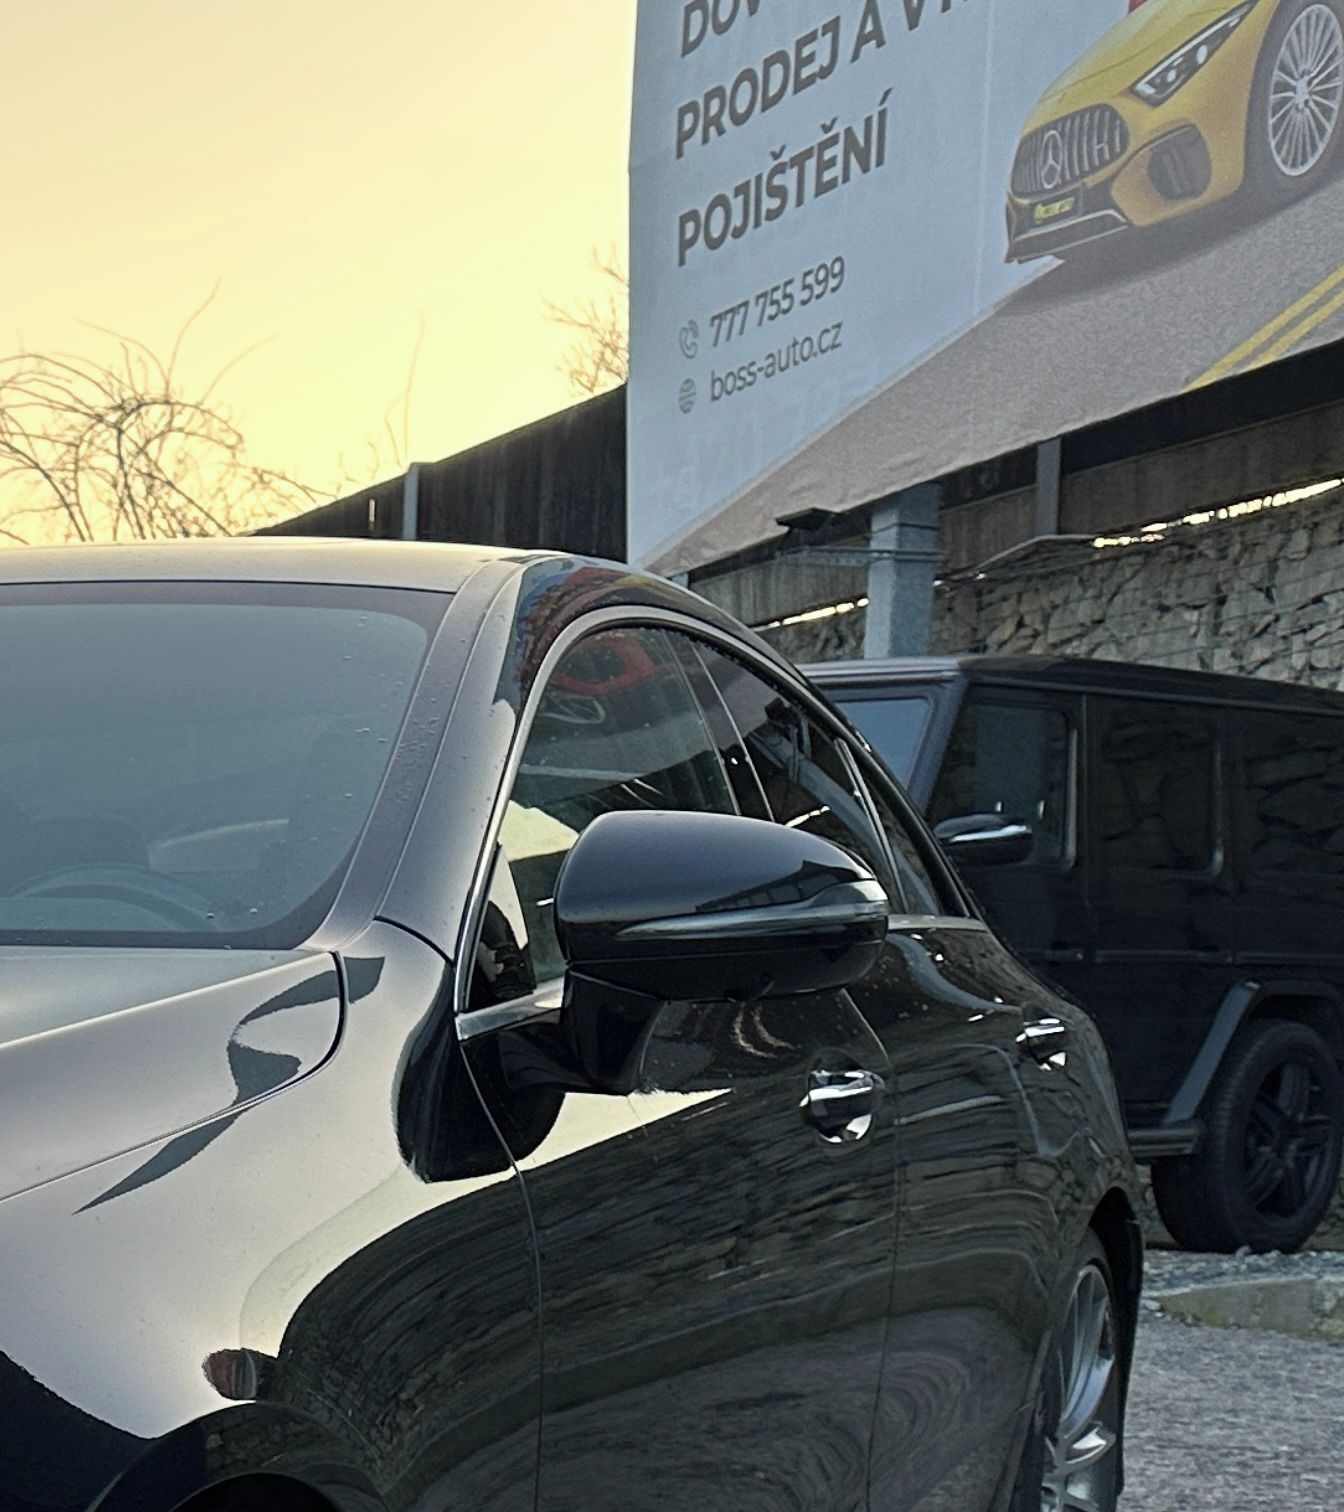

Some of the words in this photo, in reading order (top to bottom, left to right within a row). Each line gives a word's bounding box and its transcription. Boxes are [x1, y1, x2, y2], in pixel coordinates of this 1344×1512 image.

[681, 0, 760, 58] DO
[675, 15, 841, 160] PRODEJ
[849, 0, 886, 63] A
[678, 87, 894, 267] POJIŠTĚNÍ
[709, 300, 750, 348] 777
[755, 278, 795, 327] 755
[800, 255, 845, 306] 599
[710, 321, 843, 402] boss-auto.cz
